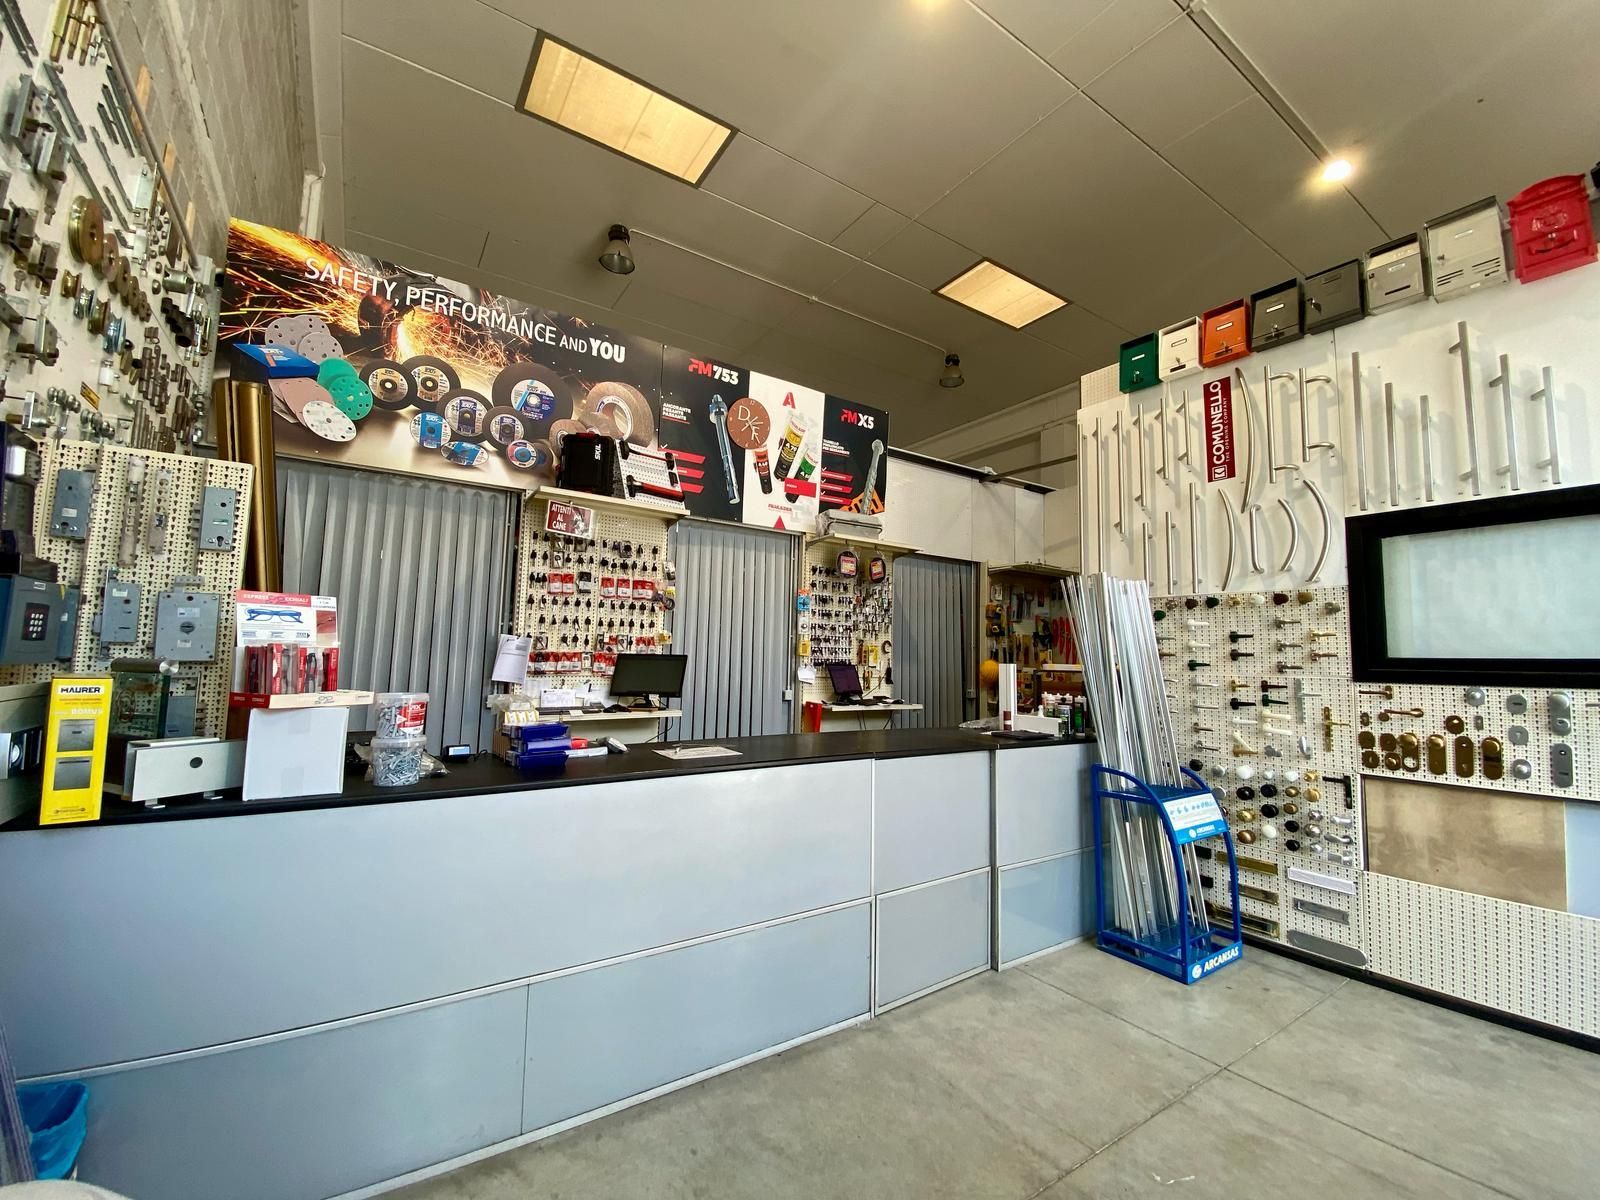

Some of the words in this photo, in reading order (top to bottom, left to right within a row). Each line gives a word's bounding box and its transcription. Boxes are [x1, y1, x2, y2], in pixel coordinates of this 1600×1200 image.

[304, 256, 400, 306] SAFETY,
[405, 285, 557, 345] PERFORMANCE
[559, 334, 588, 353] AND
[589, 337, 626, 363] YOU
[737, 405, 751, 421] D
[1209, 381, 1225, 464] COMUNELLO
[594, 443, 602, 461] SKIL
[551, 503, 571, 516] ATTENTI
[557, 513, 564, 522] AL
[552, 521, 567, 531] CANE
[60, 686, 101, 694] MAURER
[1203, 946, 1239, 974] ARCANSAS
